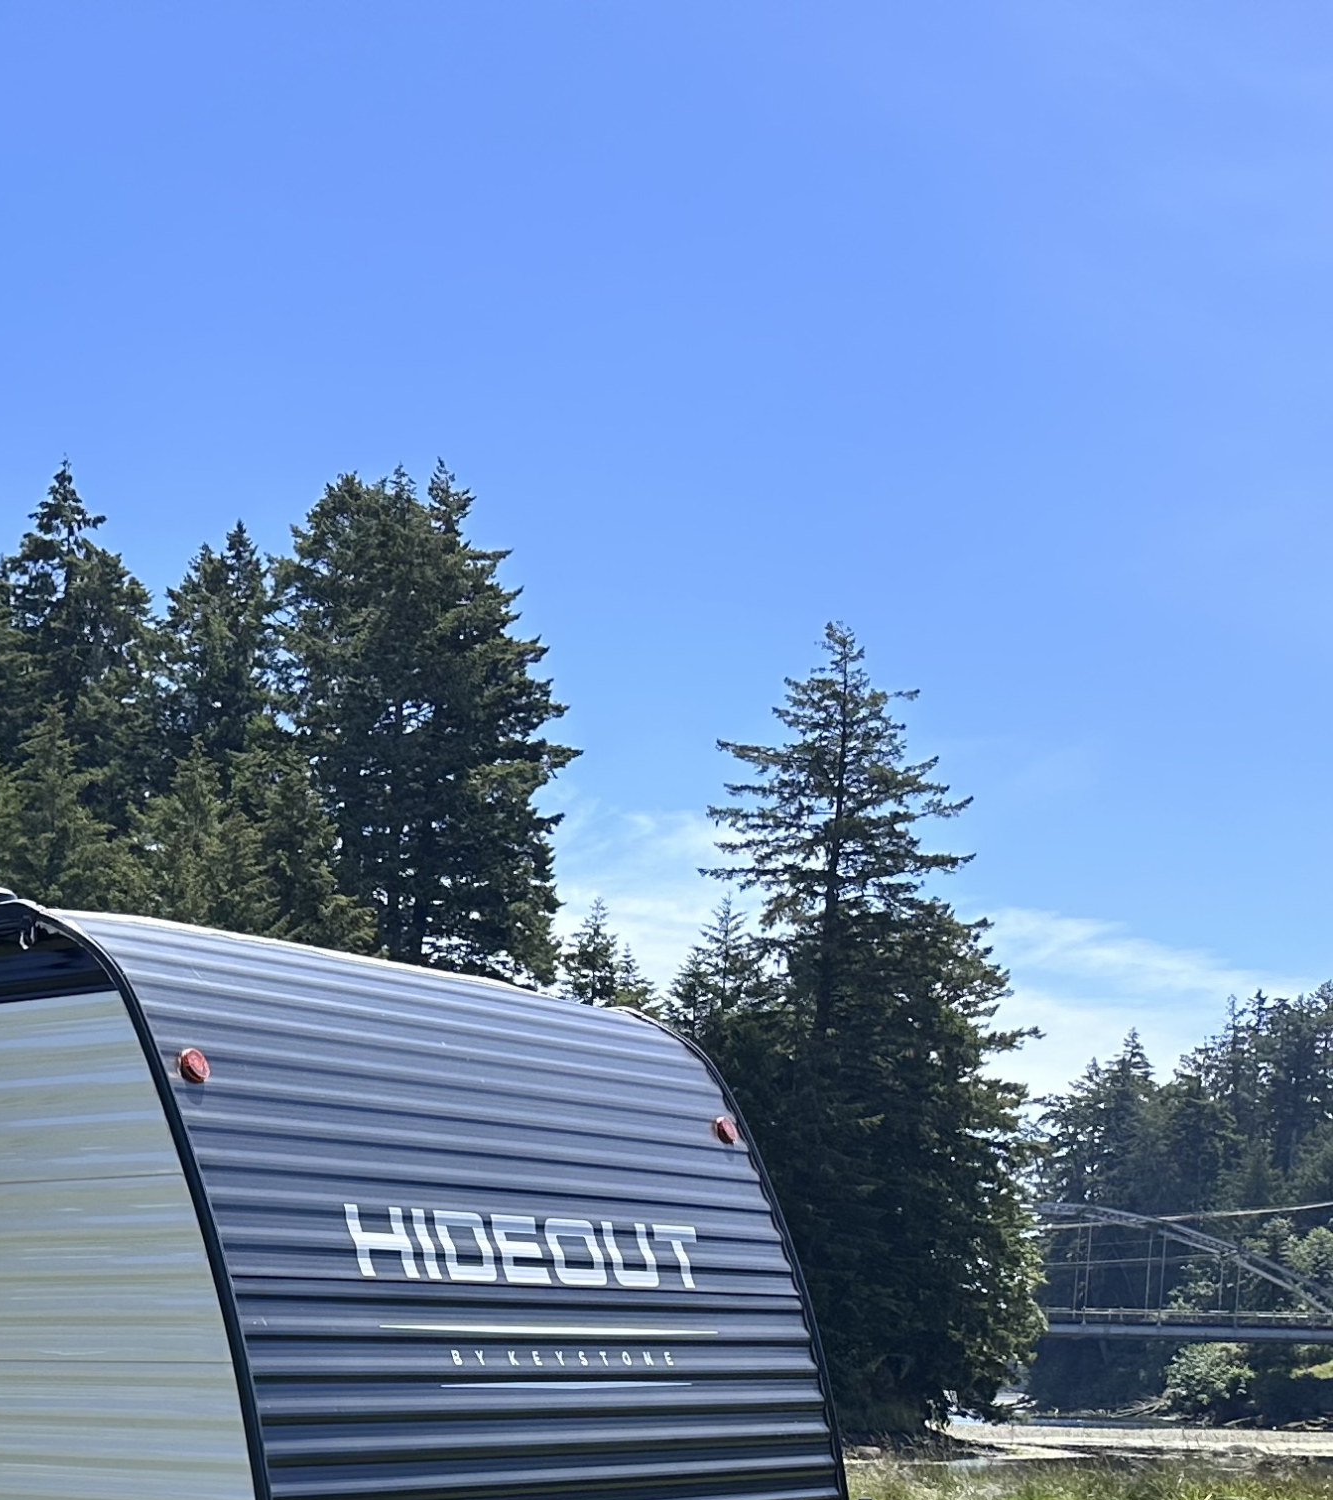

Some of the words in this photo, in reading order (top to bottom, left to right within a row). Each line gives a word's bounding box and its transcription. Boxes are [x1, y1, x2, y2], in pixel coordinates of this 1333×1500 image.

[343, 1203, 697, 1289] HIDEOUT
[450, 1349, 486, 1366] BY
[507, 1350, 675, 1367] KEYSTONE
